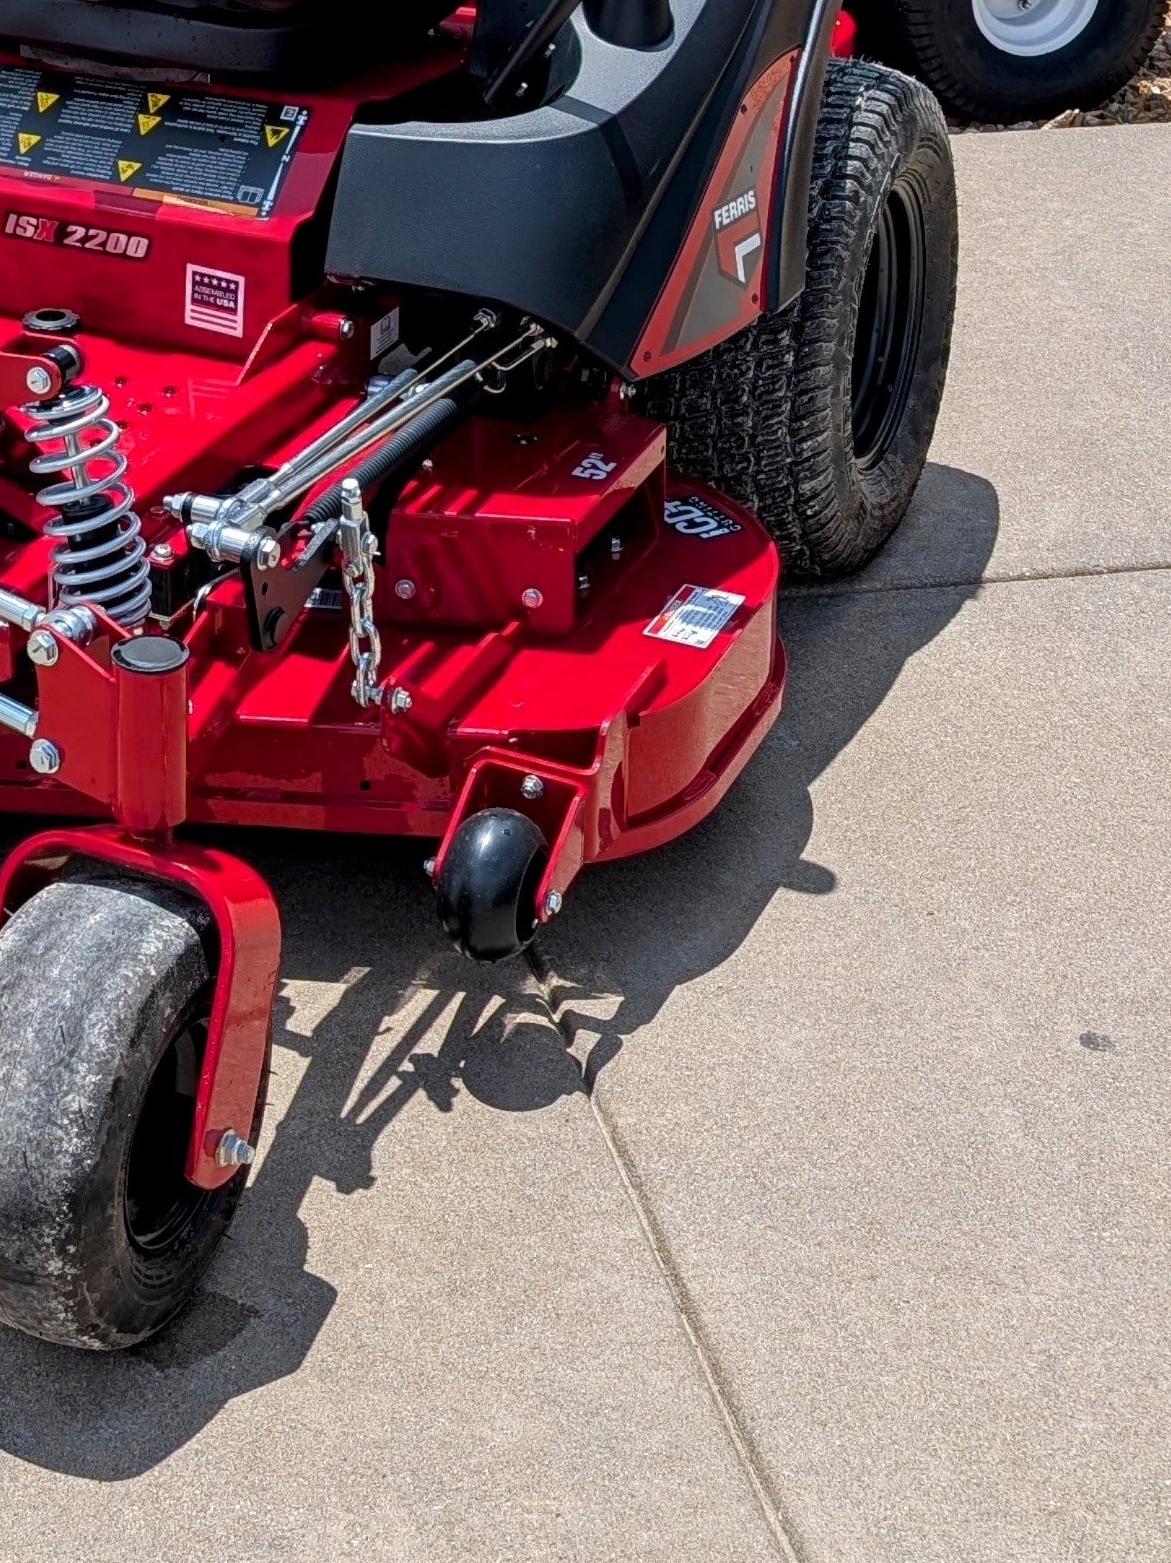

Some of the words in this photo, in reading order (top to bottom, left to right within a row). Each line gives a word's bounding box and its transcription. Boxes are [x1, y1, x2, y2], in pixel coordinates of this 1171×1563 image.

[713, 190, 756, 230] FERRIS
[4, 213, 59, 243] ISX
[63, 224, 150, 258] 2200
[216, 297, 236, 309] USA
